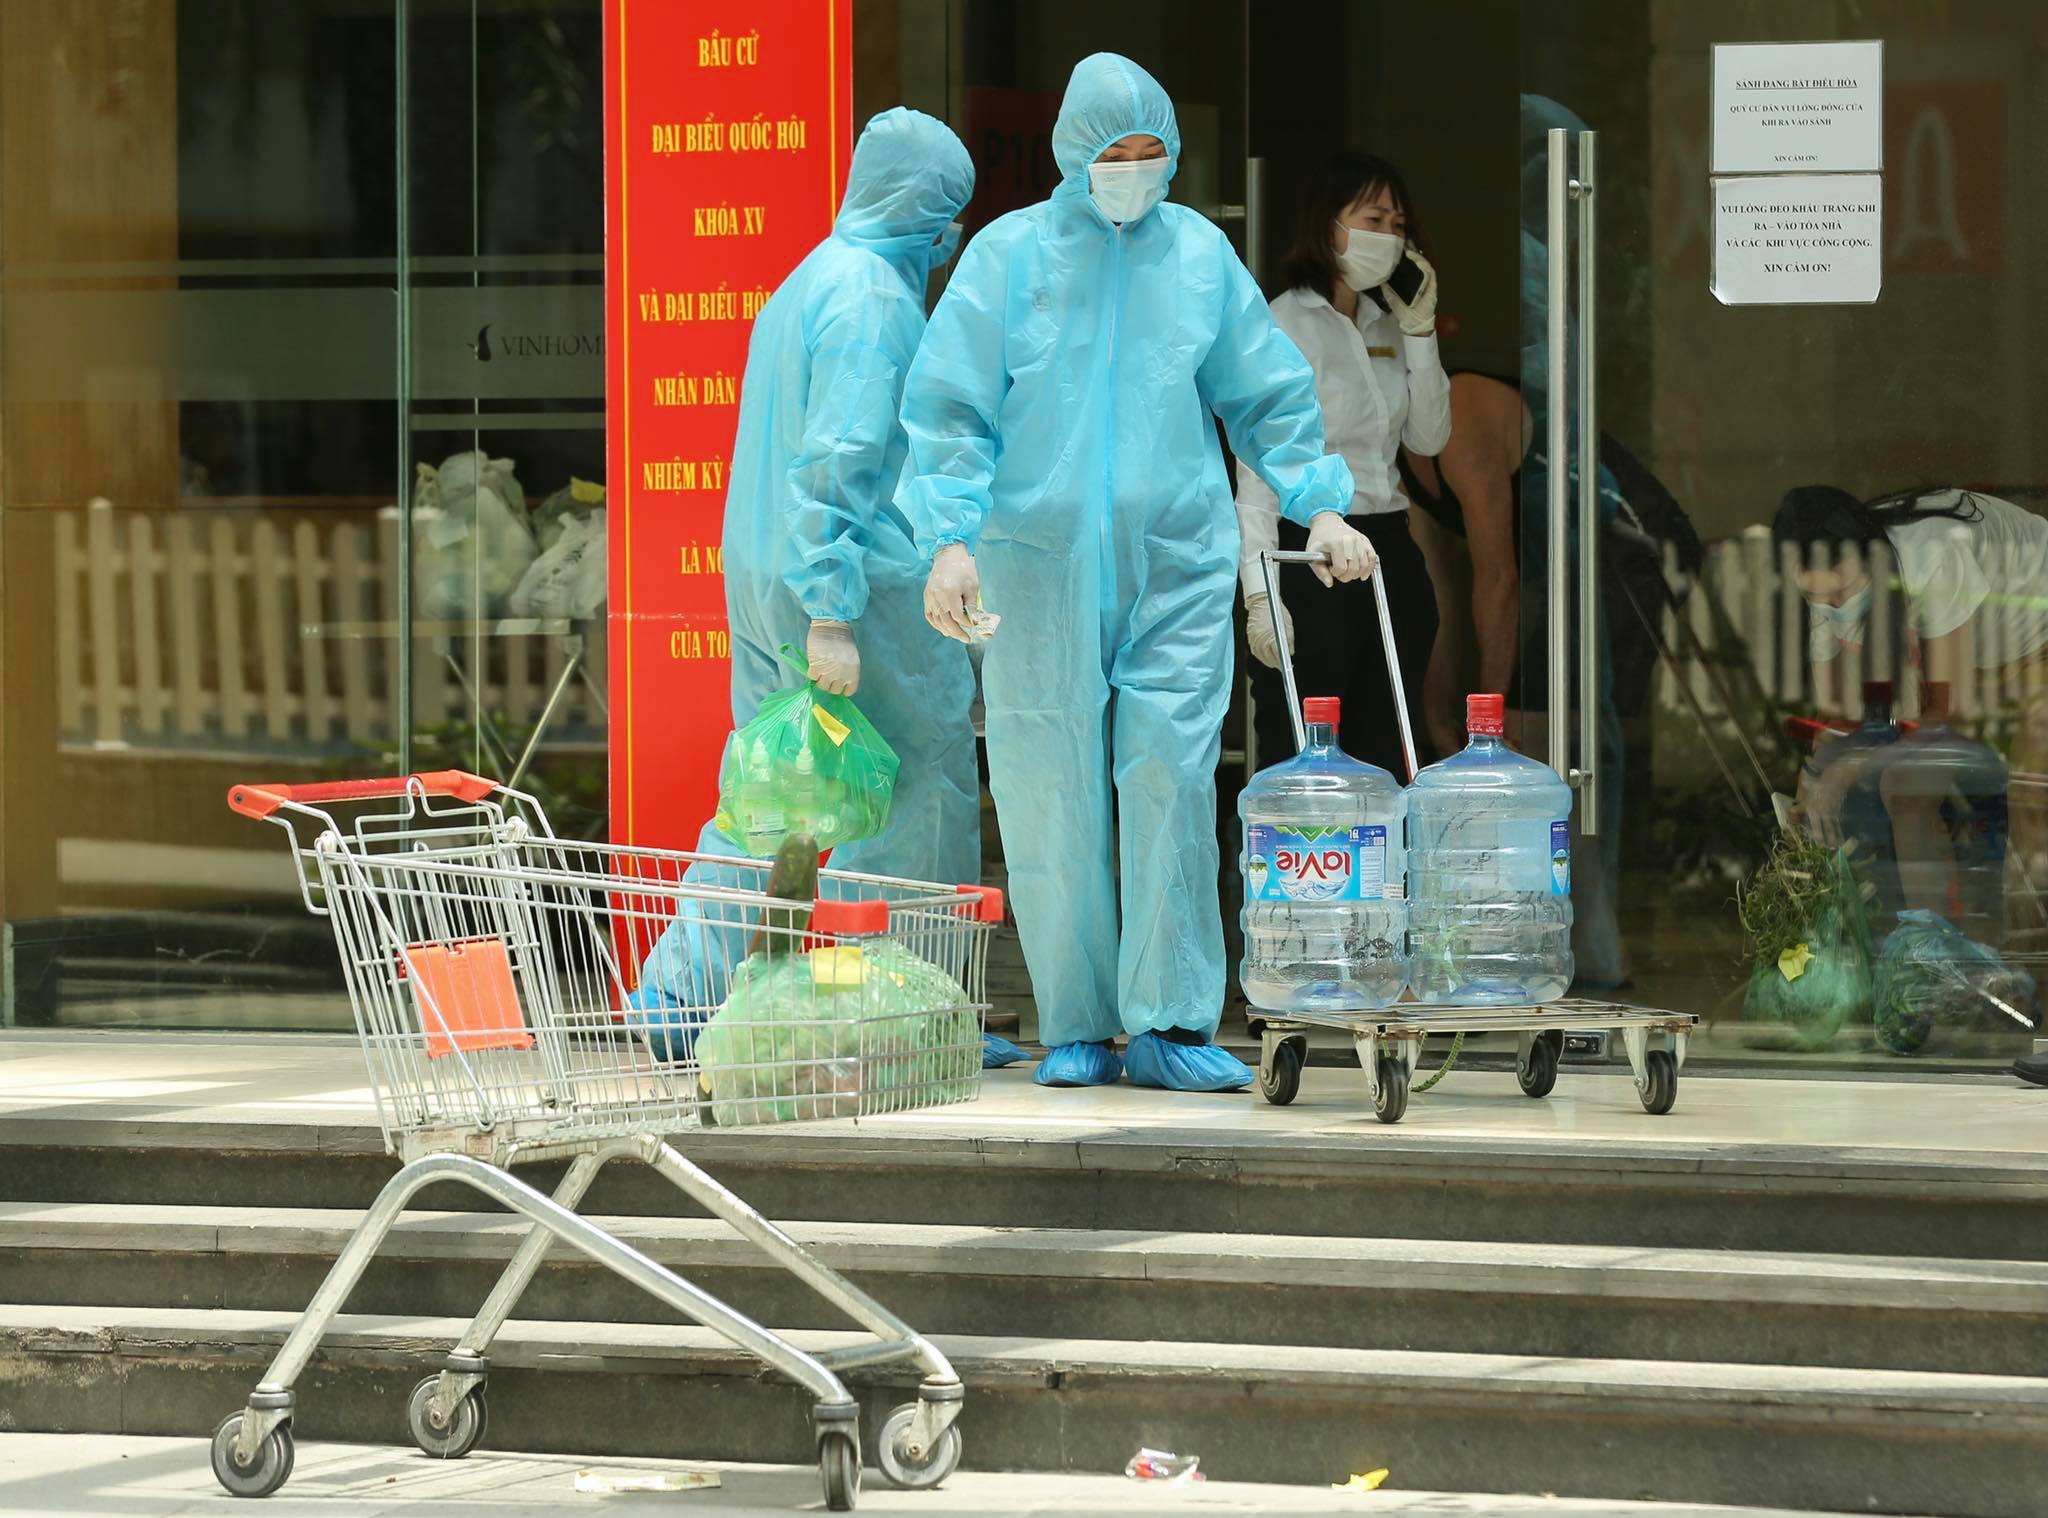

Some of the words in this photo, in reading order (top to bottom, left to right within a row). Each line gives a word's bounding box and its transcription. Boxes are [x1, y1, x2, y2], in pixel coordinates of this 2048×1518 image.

[699, 29, 731, 67] BẦU
[737, 30, 760, 66] CỬ
[1780, 104, 1796, 112] VUI
[652, 124, 680, 158] ĐẠI
[686, 112, 724, 152] BIỂU
[729, 112, 772, 154] QUỐC
[776, 114, 806, 154] HỘI
[694, 201, 738, 237] KHÓA
[744, 206, 765, 235] XV
[1740, 203, 1767, 213] LÒNG
[1770, 205, 1789, 213] ĐEO
[1822, 204, 1856, 213] TRANG
[1858, 204, 1877, 212] KHI
[1754, 223, 1767, 231] RA
[1776, 220, 1797, 230] VÀO
[1821, 219, 1842, 230] NHÀ
[1726, 237, 1739, 247] VÀ
[1741, 237, 1761, 247] CÁC
[1766, 239, 1787, 247] KHU
[1788, 238, 1812, 249] VỰC
[1812, 236, 1840, 247] CÔNG
[1764, 264, 1782, 272] XIN
[1785, 260, 1810, 272] CẢM
[1812, 263, 1831, 272] ƠN!
[639, 288, 660, 322] VÀ
[665, 292, 693, 326] ĐẠI
[699, 281, 736, 320] BIỂU
[502, 336, 605, 356] VINHOM
[654, 371, 698, 406] NHÂN
[703, 371, 735, 405] DÂN
[643, 456, 696, 495] NHIỆM
[702, 455, 723, 490] KỲ
[680, 540, 701, 574] LÀ
[671, 624, 703, 659] CỦA
